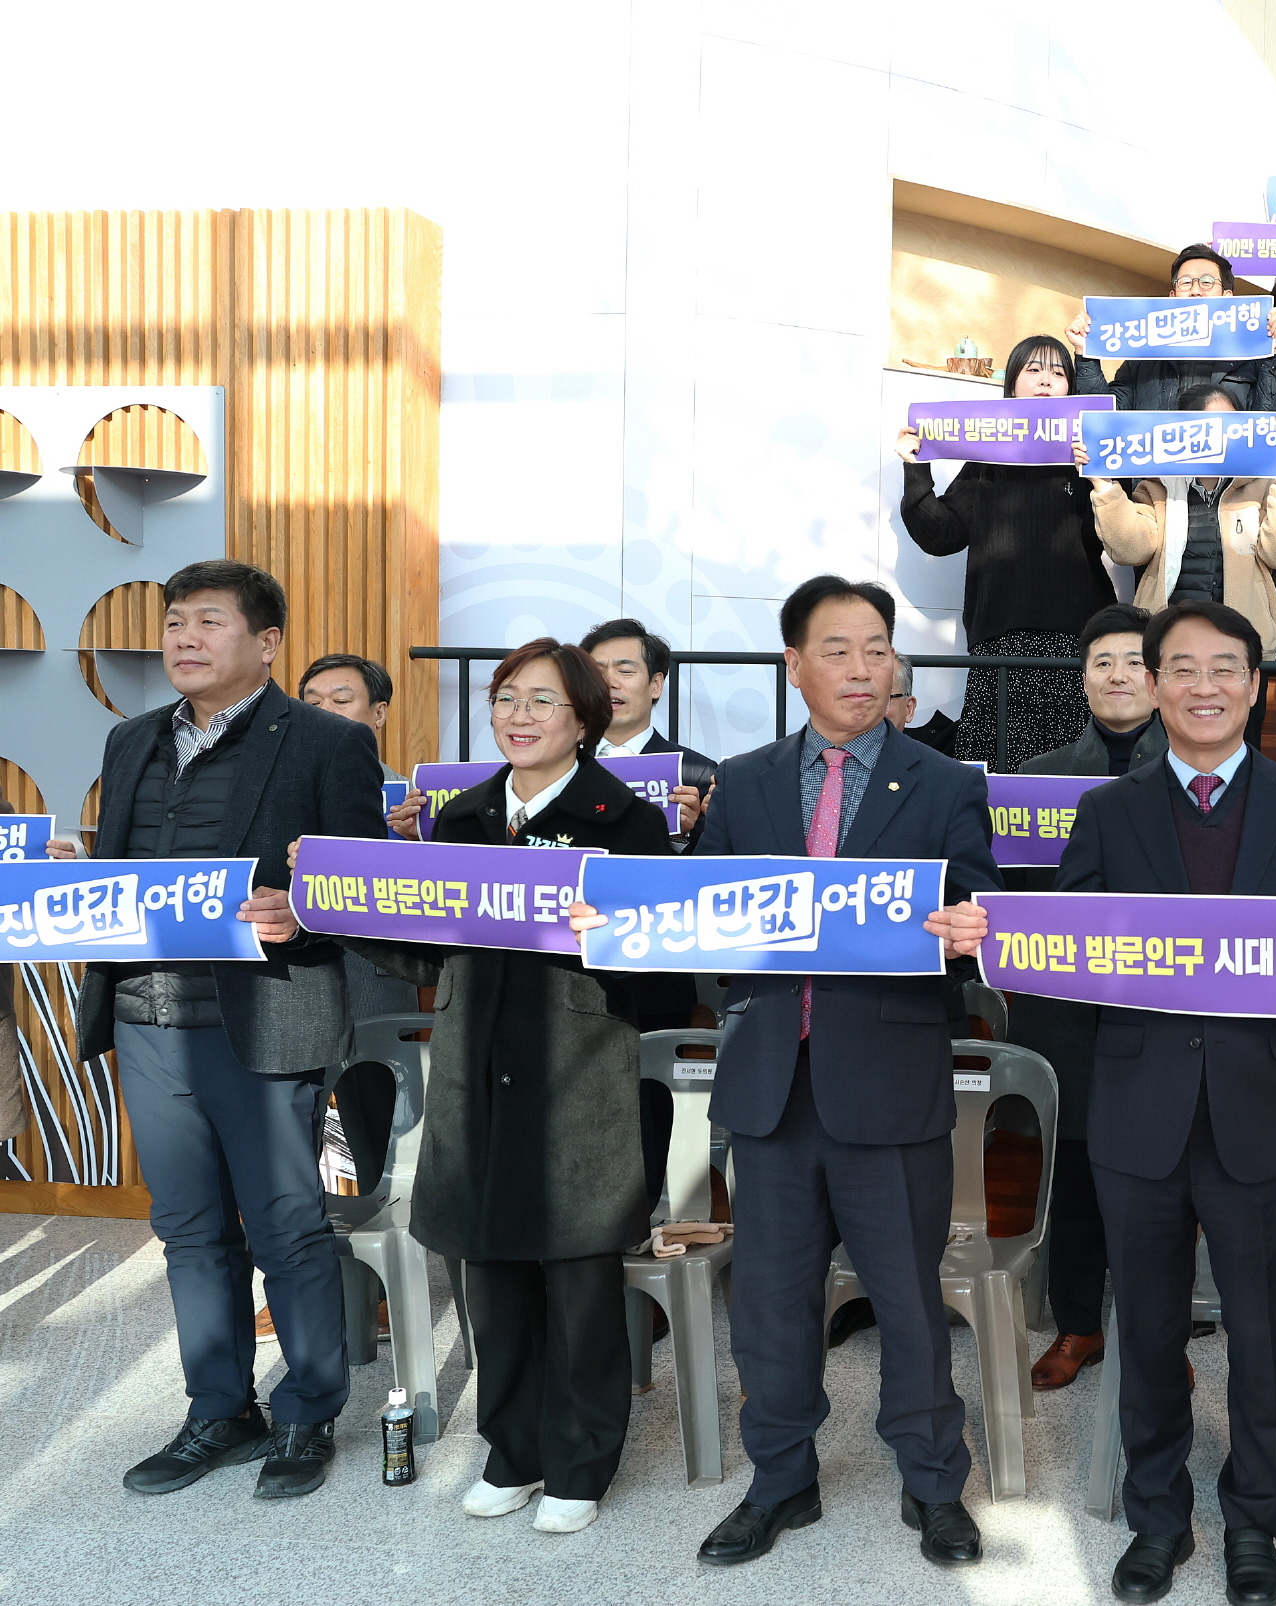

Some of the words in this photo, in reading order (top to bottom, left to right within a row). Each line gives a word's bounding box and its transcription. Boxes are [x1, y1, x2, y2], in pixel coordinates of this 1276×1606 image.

[1217, 238, 1254, 258] 700만
[1100, 323, 1146, 352] 강진
[1155, 312, 1200, 338] 반값
[1212, 302, 1261, 332] 여행
[916, 418, 960, 442] 700만
[964, 418, 1029, 442] 방문인구
[1034, 418, 1065, 442] 시대
[1099, 437, 1148, 470] 강진
[1161, 425, 1213, 454] 반값
[988, 806, 1031, 837] 0만
[1037, 808, 1077, 839] 방문
[47, 880, 124, 934] 반값
[144, 868, 228, 922] 여행
[302, 874, 368, 912] 700만
[373, 878, 469, 917] 방문인구
[477, 883, 526, 922] 시대
[614, 900, 697, 959] 강진
[713, 879, 800, 938] 반값
[821, 868, 915, 926] 여행
[996, 933, 1077, 972] 700만
[1085, 935, 1204, 976] 방문인구
[1214, 937, 1274, 976] 시대
